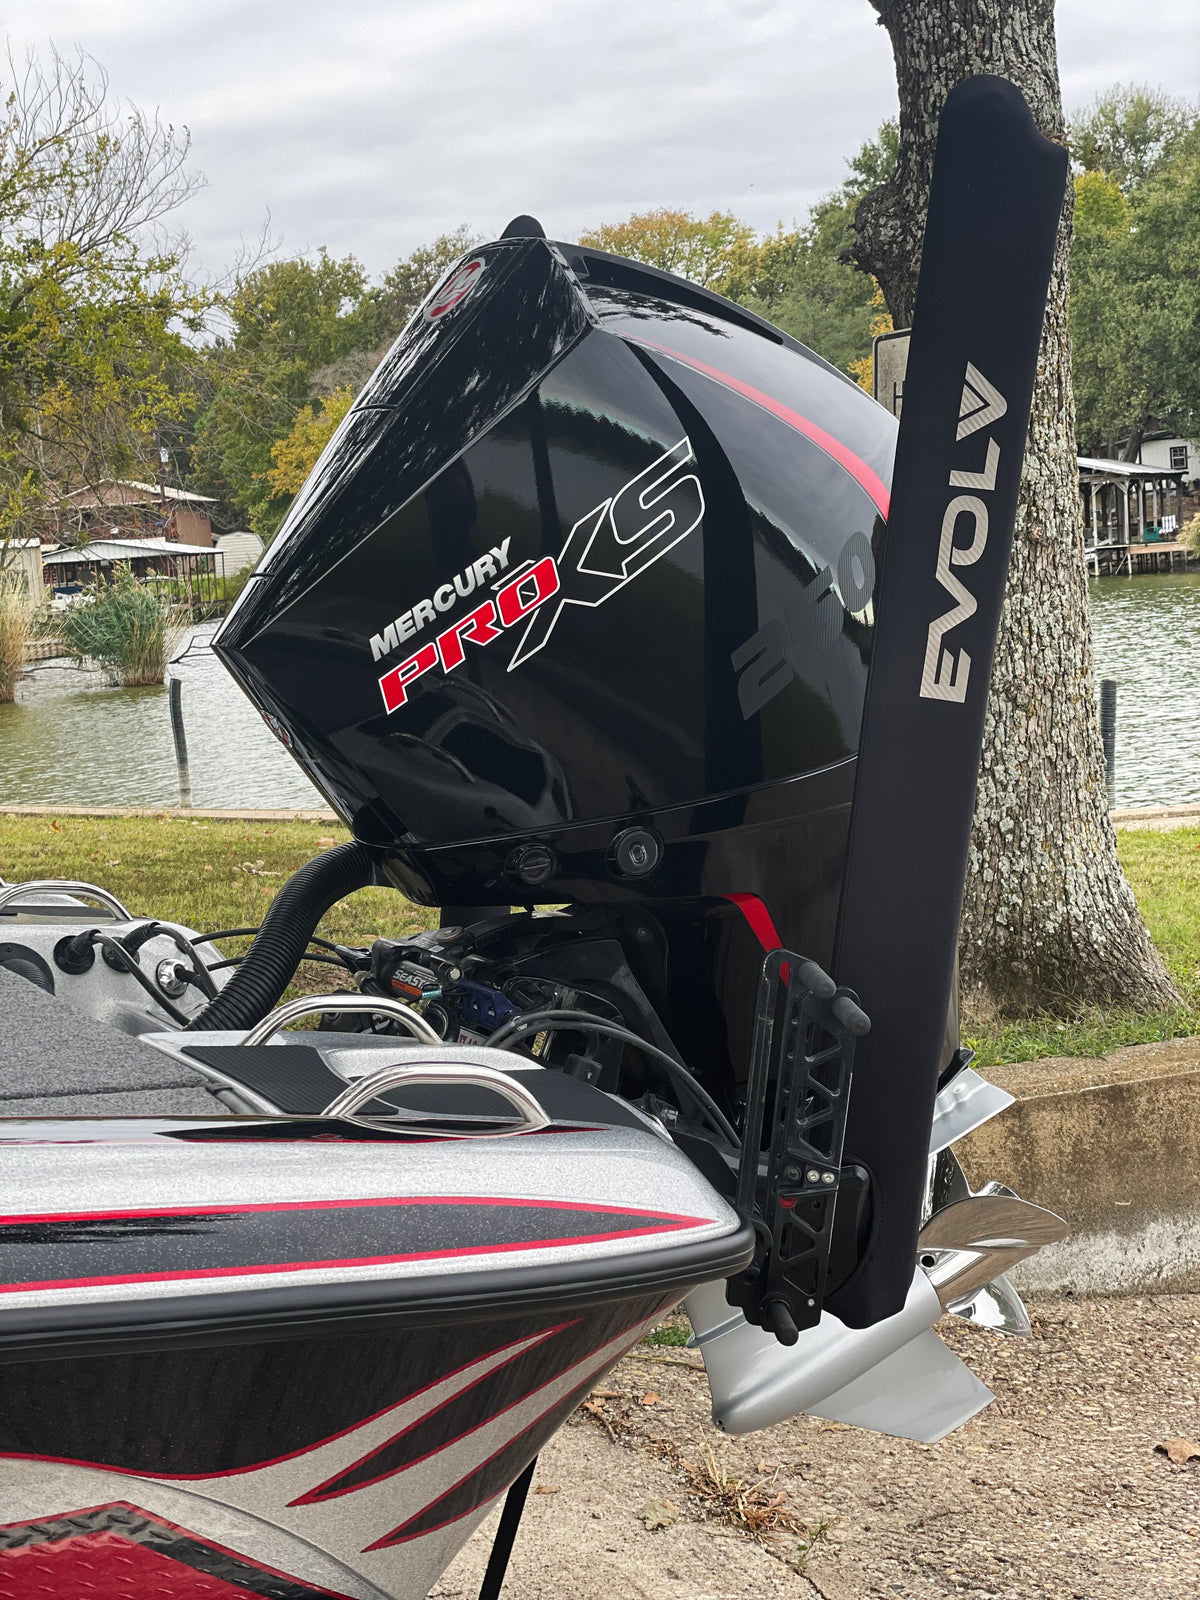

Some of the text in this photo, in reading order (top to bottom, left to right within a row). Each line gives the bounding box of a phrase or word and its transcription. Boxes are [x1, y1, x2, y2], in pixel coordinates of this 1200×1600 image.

[369, 536, 511, 662] MERCURY
[920, 361, 1008, 703] EVOLV
[378, 556, 561, 715] PRO
[392, 969, 430, 990] SEAST
